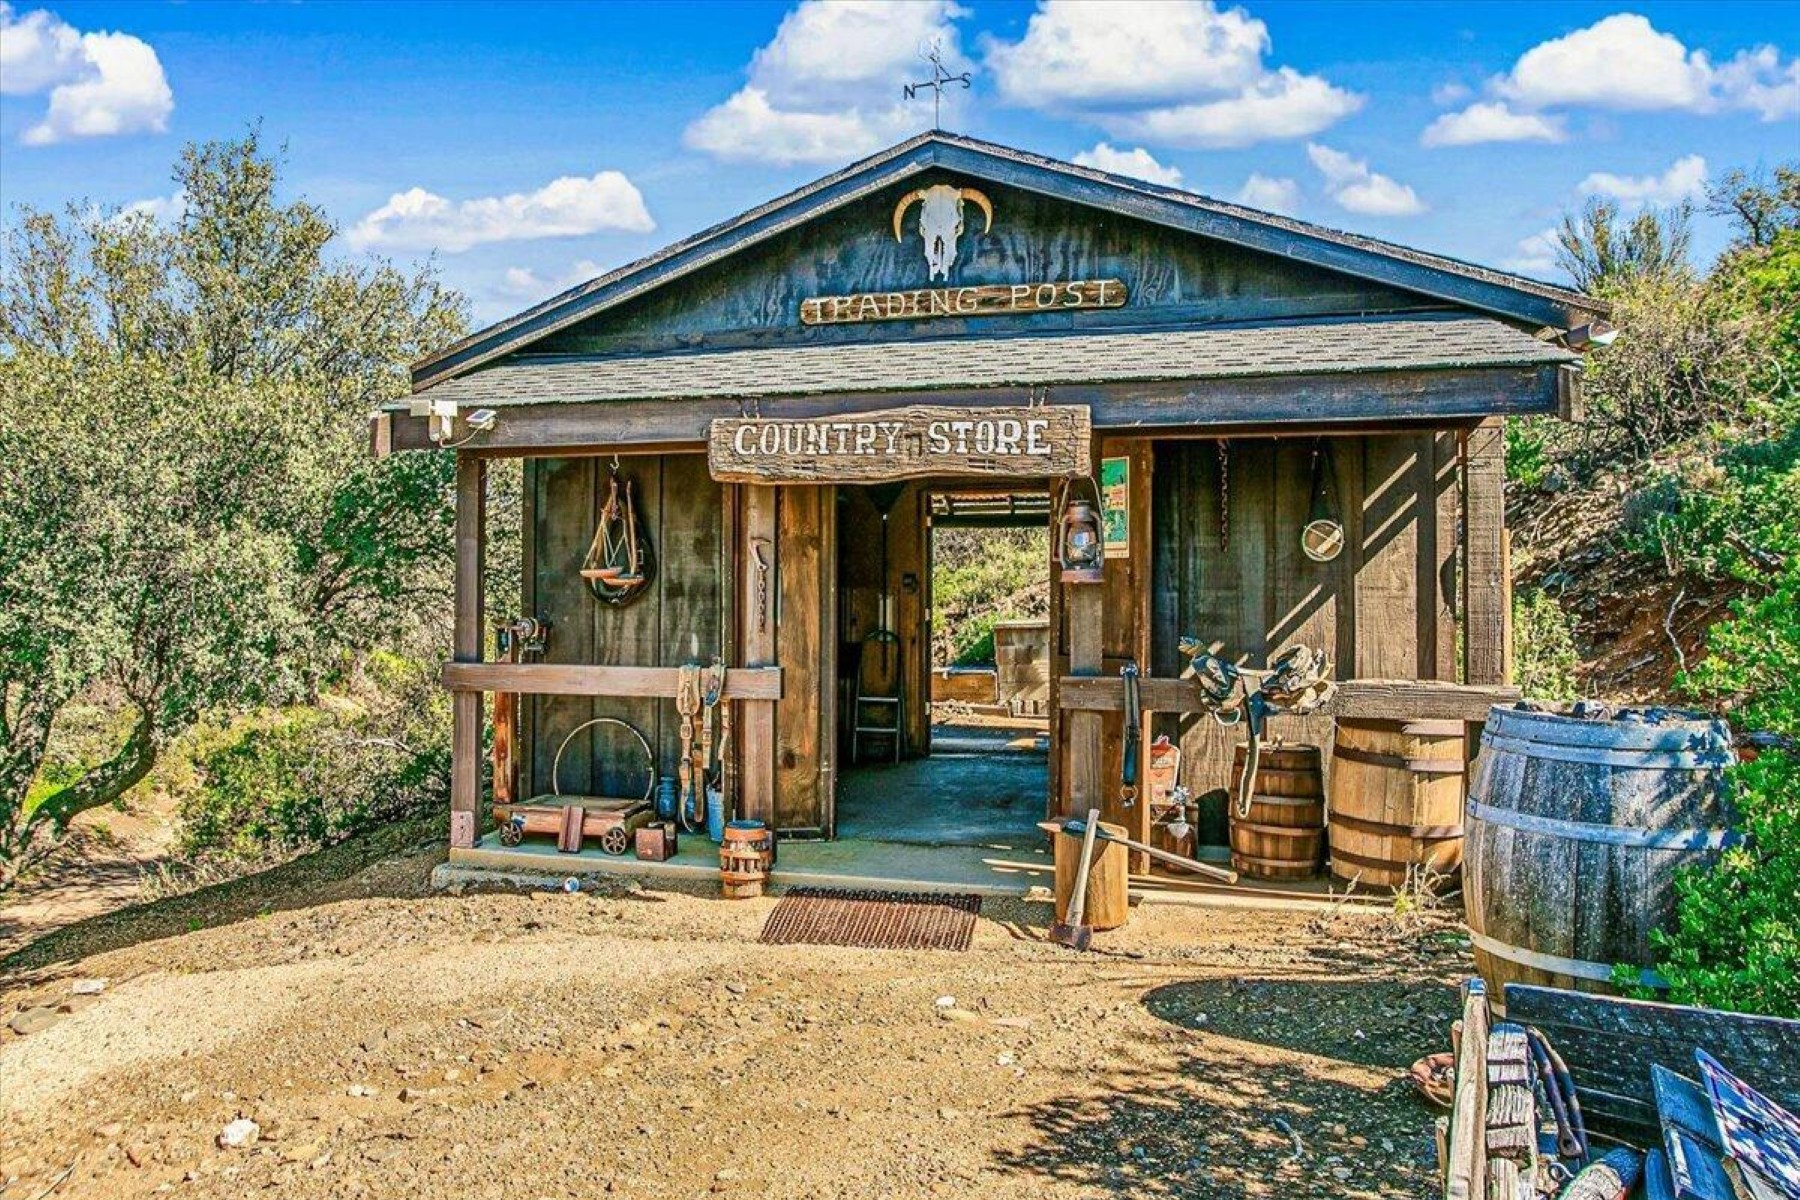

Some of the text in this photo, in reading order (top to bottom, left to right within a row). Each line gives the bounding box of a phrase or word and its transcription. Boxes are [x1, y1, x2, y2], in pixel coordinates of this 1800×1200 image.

[903, 84, 916, 100] N
[811, 280, 1116, 323] TRADING POST
[733, 418, 1054, 456] COUNTRY STORE
